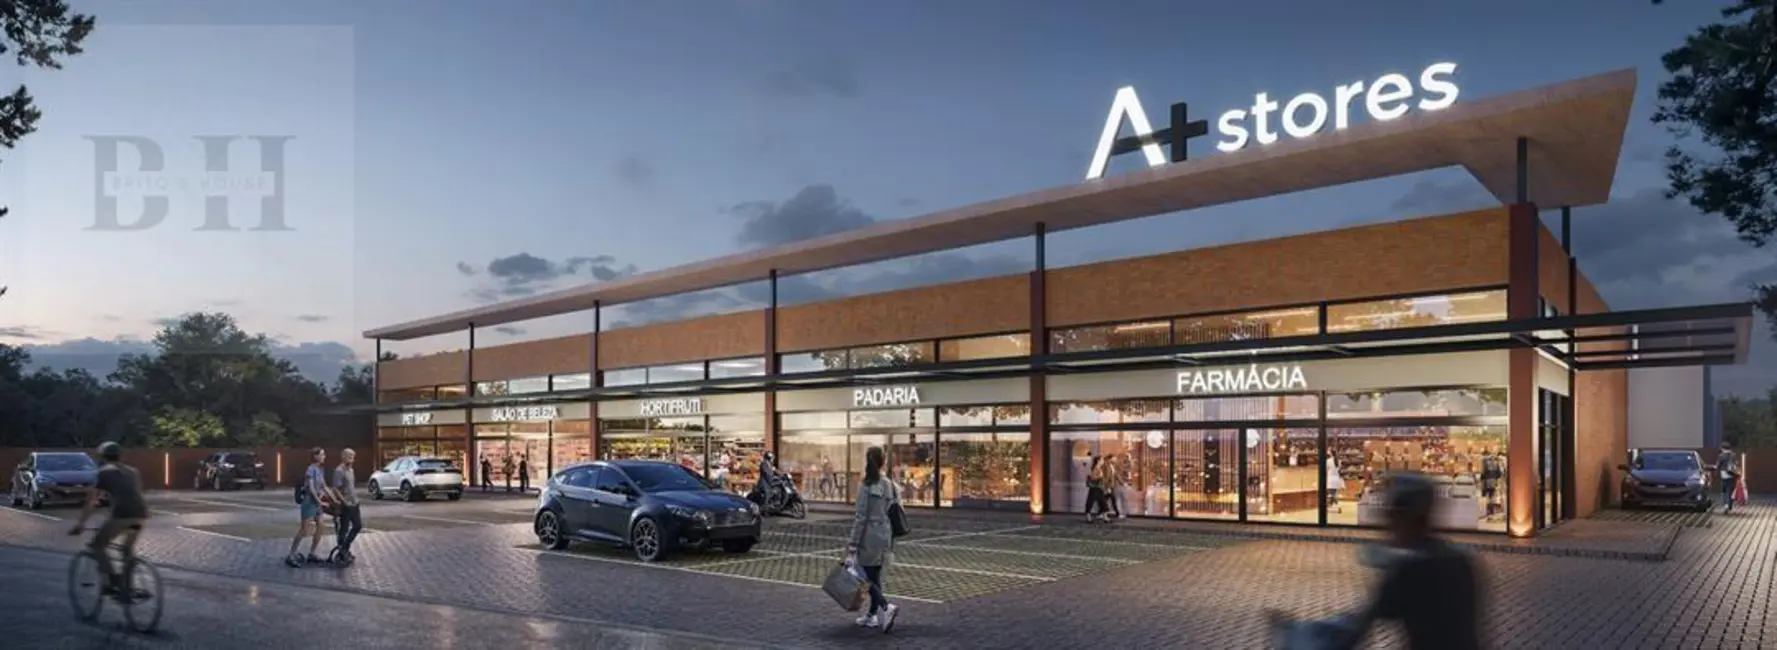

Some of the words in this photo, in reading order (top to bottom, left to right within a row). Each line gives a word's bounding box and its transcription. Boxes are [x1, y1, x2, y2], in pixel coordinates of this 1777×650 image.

[1216, 61, 1460, 153] stores
[1177, 364, 1307, 393] FARMÁCIA
[853, 386, 920, 407] PADARIA
